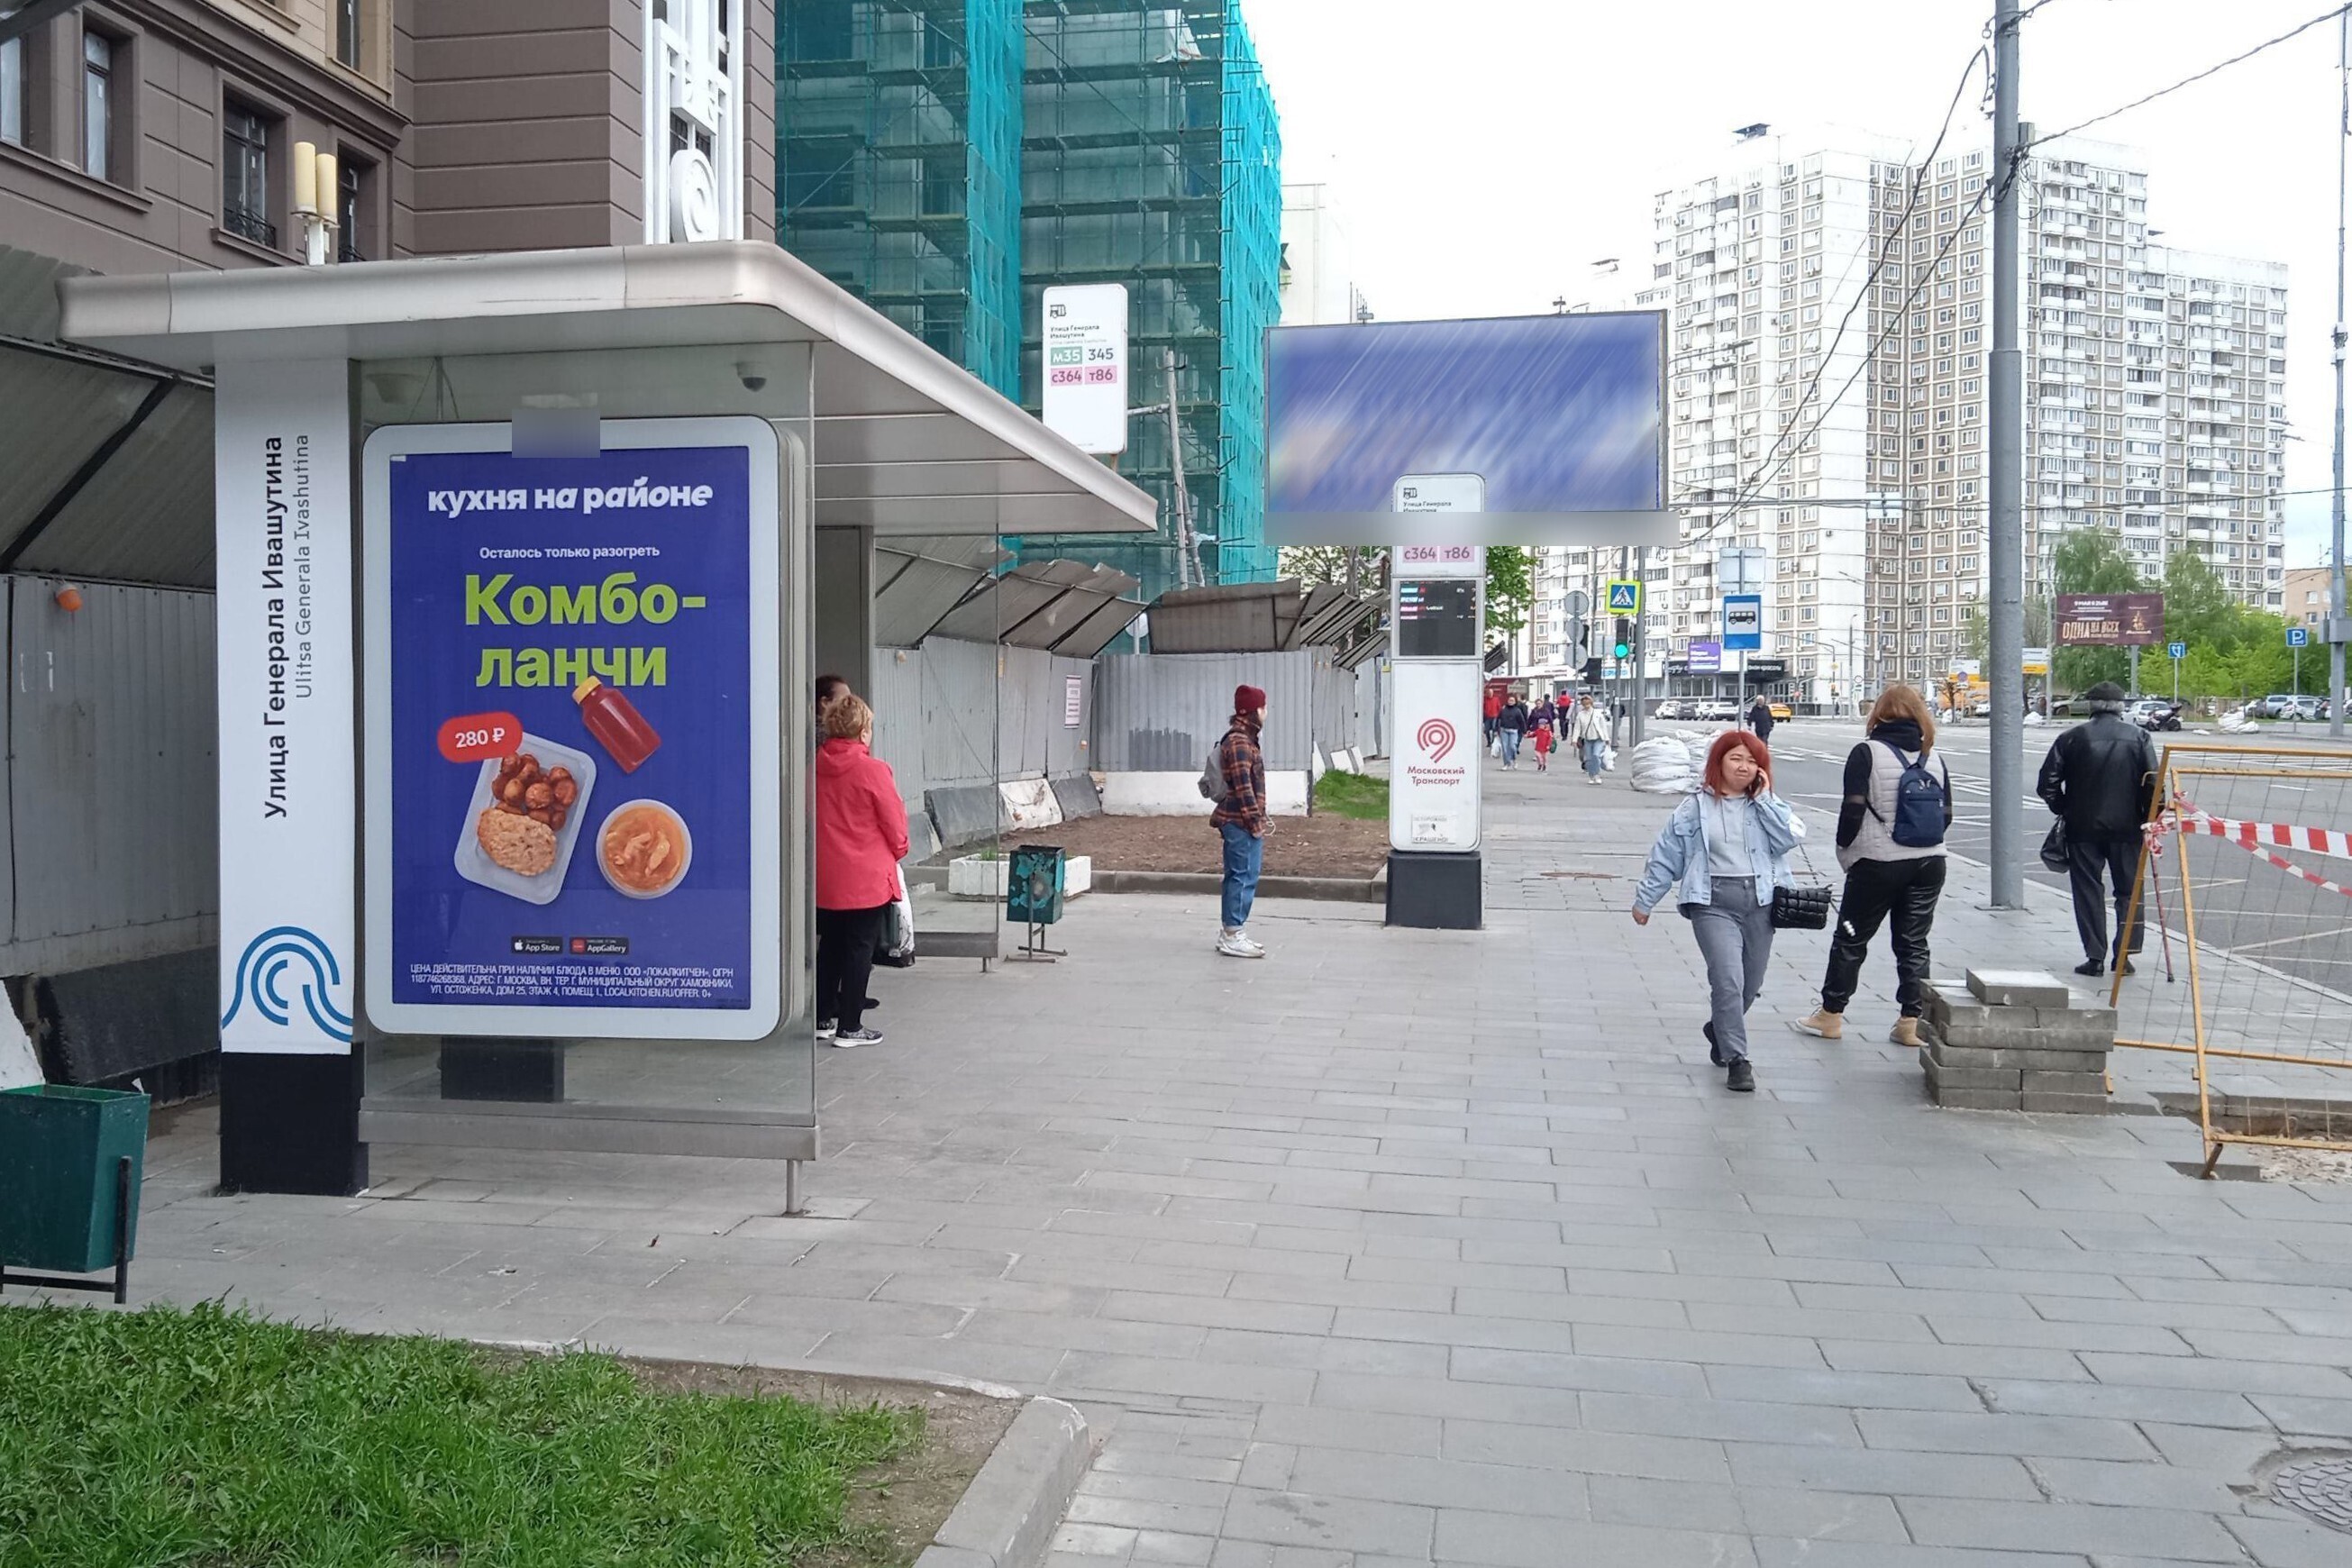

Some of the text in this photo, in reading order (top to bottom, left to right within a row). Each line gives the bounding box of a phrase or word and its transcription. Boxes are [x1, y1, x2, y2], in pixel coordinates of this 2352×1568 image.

[1053, 348, 1114, 363] м35 345
[1052, 369, 1113, 383] с364 т86
[428, 476, 714, 518] кухня на районе
[479, 546, 660, 560] Осталось только разогреть
[1404, 546, 1470, 560] с364 т86
[293, 434, 312, 698] Ulitsa Generala Ivashutina
[465, 571, 707, 625] Комбо-
[262, 436, 289, 819] Улица Генерала Ивашутина
[2062, 621, 2090, 640] ОДНА
[476, 646, 667, 688] ланчи
[455, 729, 489, 749] 280
[1407, 766, 1465, 775] Московский
[1412, 776, 1460, 787] Транспорт
[525, 944, 560, 953] App Store
[587, 944, 627, 954] AppGallery
[410, 963, 432, 974] ЦЕНА
[433, 962, 497, 974] ДЕЙСТВИТЕЛЬНА
[498, 965, 515, 974] ПРИ
[516, 965, 555, 975] НАЛИЧИИ
[556, 966, 587, 976] БЛЮДА
[588, 966, 594, 975] В
[624, 966, 642, 976] ООО
[712, 968, 734, 977] ОГРН
[578, 976, 652, 987] МУНИЦИПАЛЬНЫЙ
[653, 978, 678, 987] ОКРУГ
[679, 978, 734, 989] ХАМОВНИКИ,
[444, 985, 494, 995] ОСТОЖЕНКА,
[496, 986, 515, 996] ДОМ
[528, 987, 552, 995] ЭТАЖ
[701, 989, 712, 998] 0+
